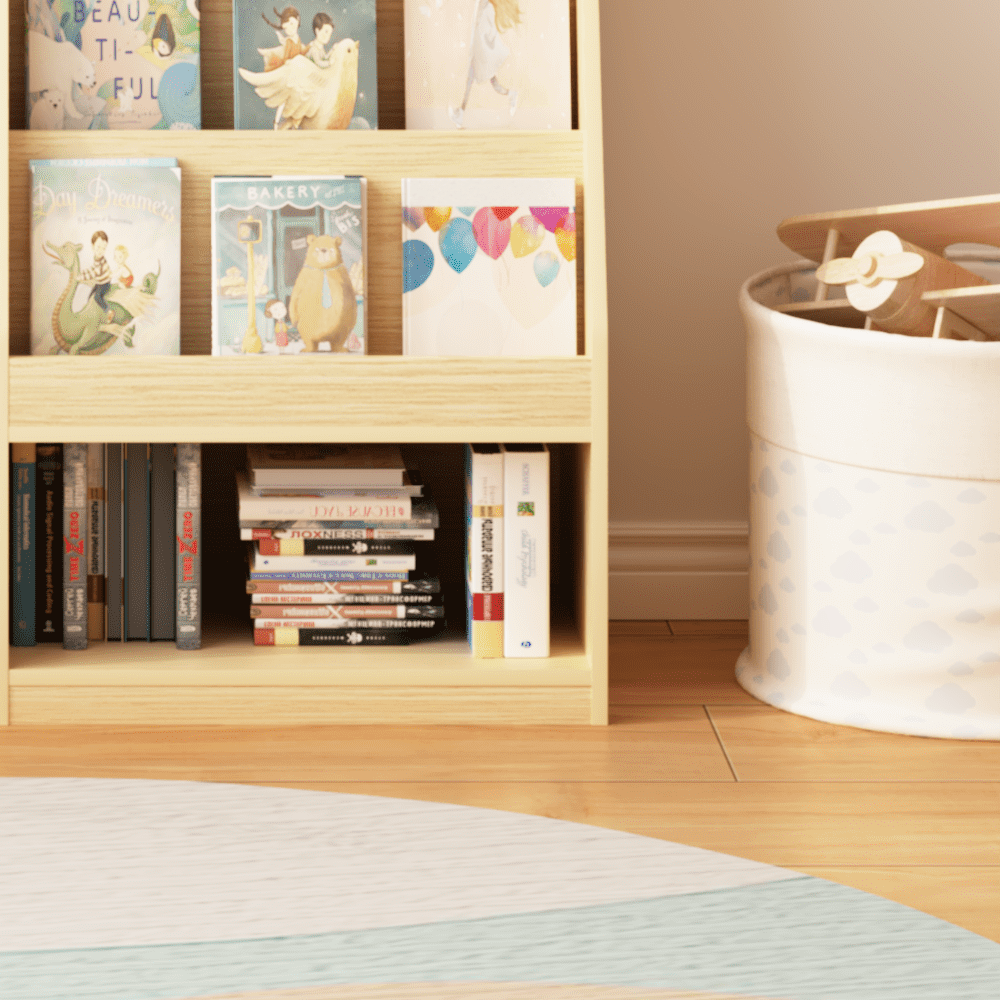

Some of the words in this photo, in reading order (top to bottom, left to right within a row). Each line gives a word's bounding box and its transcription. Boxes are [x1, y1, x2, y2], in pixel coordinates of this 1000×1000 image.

[74, 0, 155, 22] BEAU-
[96, 38, 133, 61] TI-
[85, 177, 175, 222] Dreamers
[247, 185, 320, 201] BAKERY
